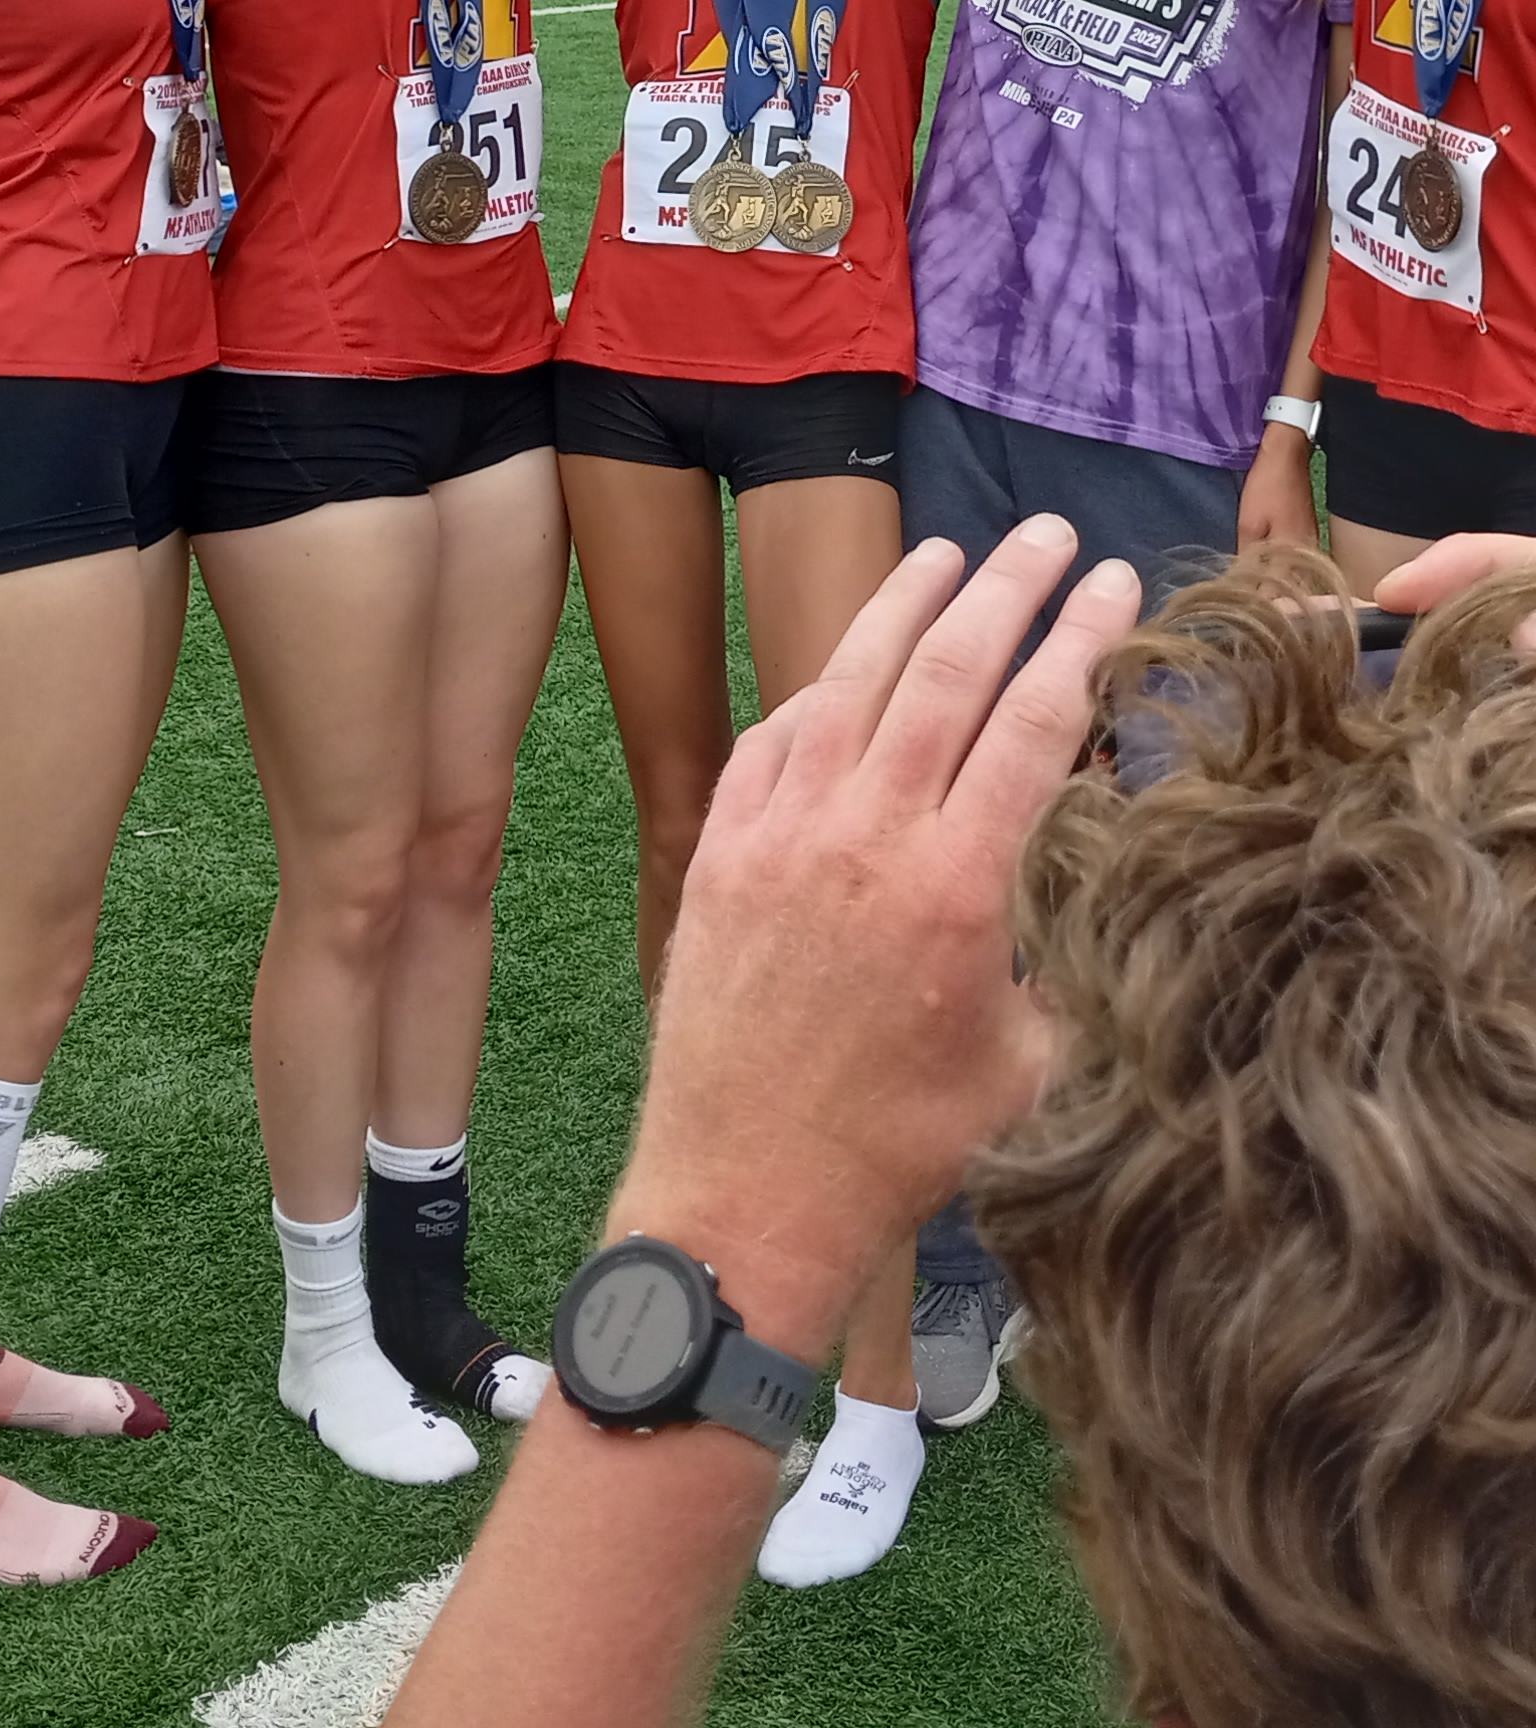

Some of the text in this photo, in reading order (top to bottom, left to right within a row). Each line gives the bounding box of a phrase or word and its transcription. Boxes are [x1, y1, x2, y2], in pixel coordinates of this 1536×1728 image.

[1062, 3, 1075, 27] &
[1072, 9, 1122, 46] FIELD
[1128, 27, 1163, 49] 2022
[1030, 31, 1077, 62] PIAA
[406, 62, 529, 98] 202 AAA GIRLS
[410, 76, 532, 107] TRAC CHAMPIONSHIPS
[649, 80, 724, 94] 2022 PIA
[651, 94, 723, 105] TRACK & FIEL
[1056, 110, 1076, 126] PA
[1351, 90, 1480, 155] 2022 PIAA AAA GIRLS
[1375, 120, 1395, 136] FIELD
[1396, 130, 1468, 165] CHAMPSHIPS
[1368, 238, 1448, 288] ATHLETIC
[820, 1492, 869, 1514] balega
